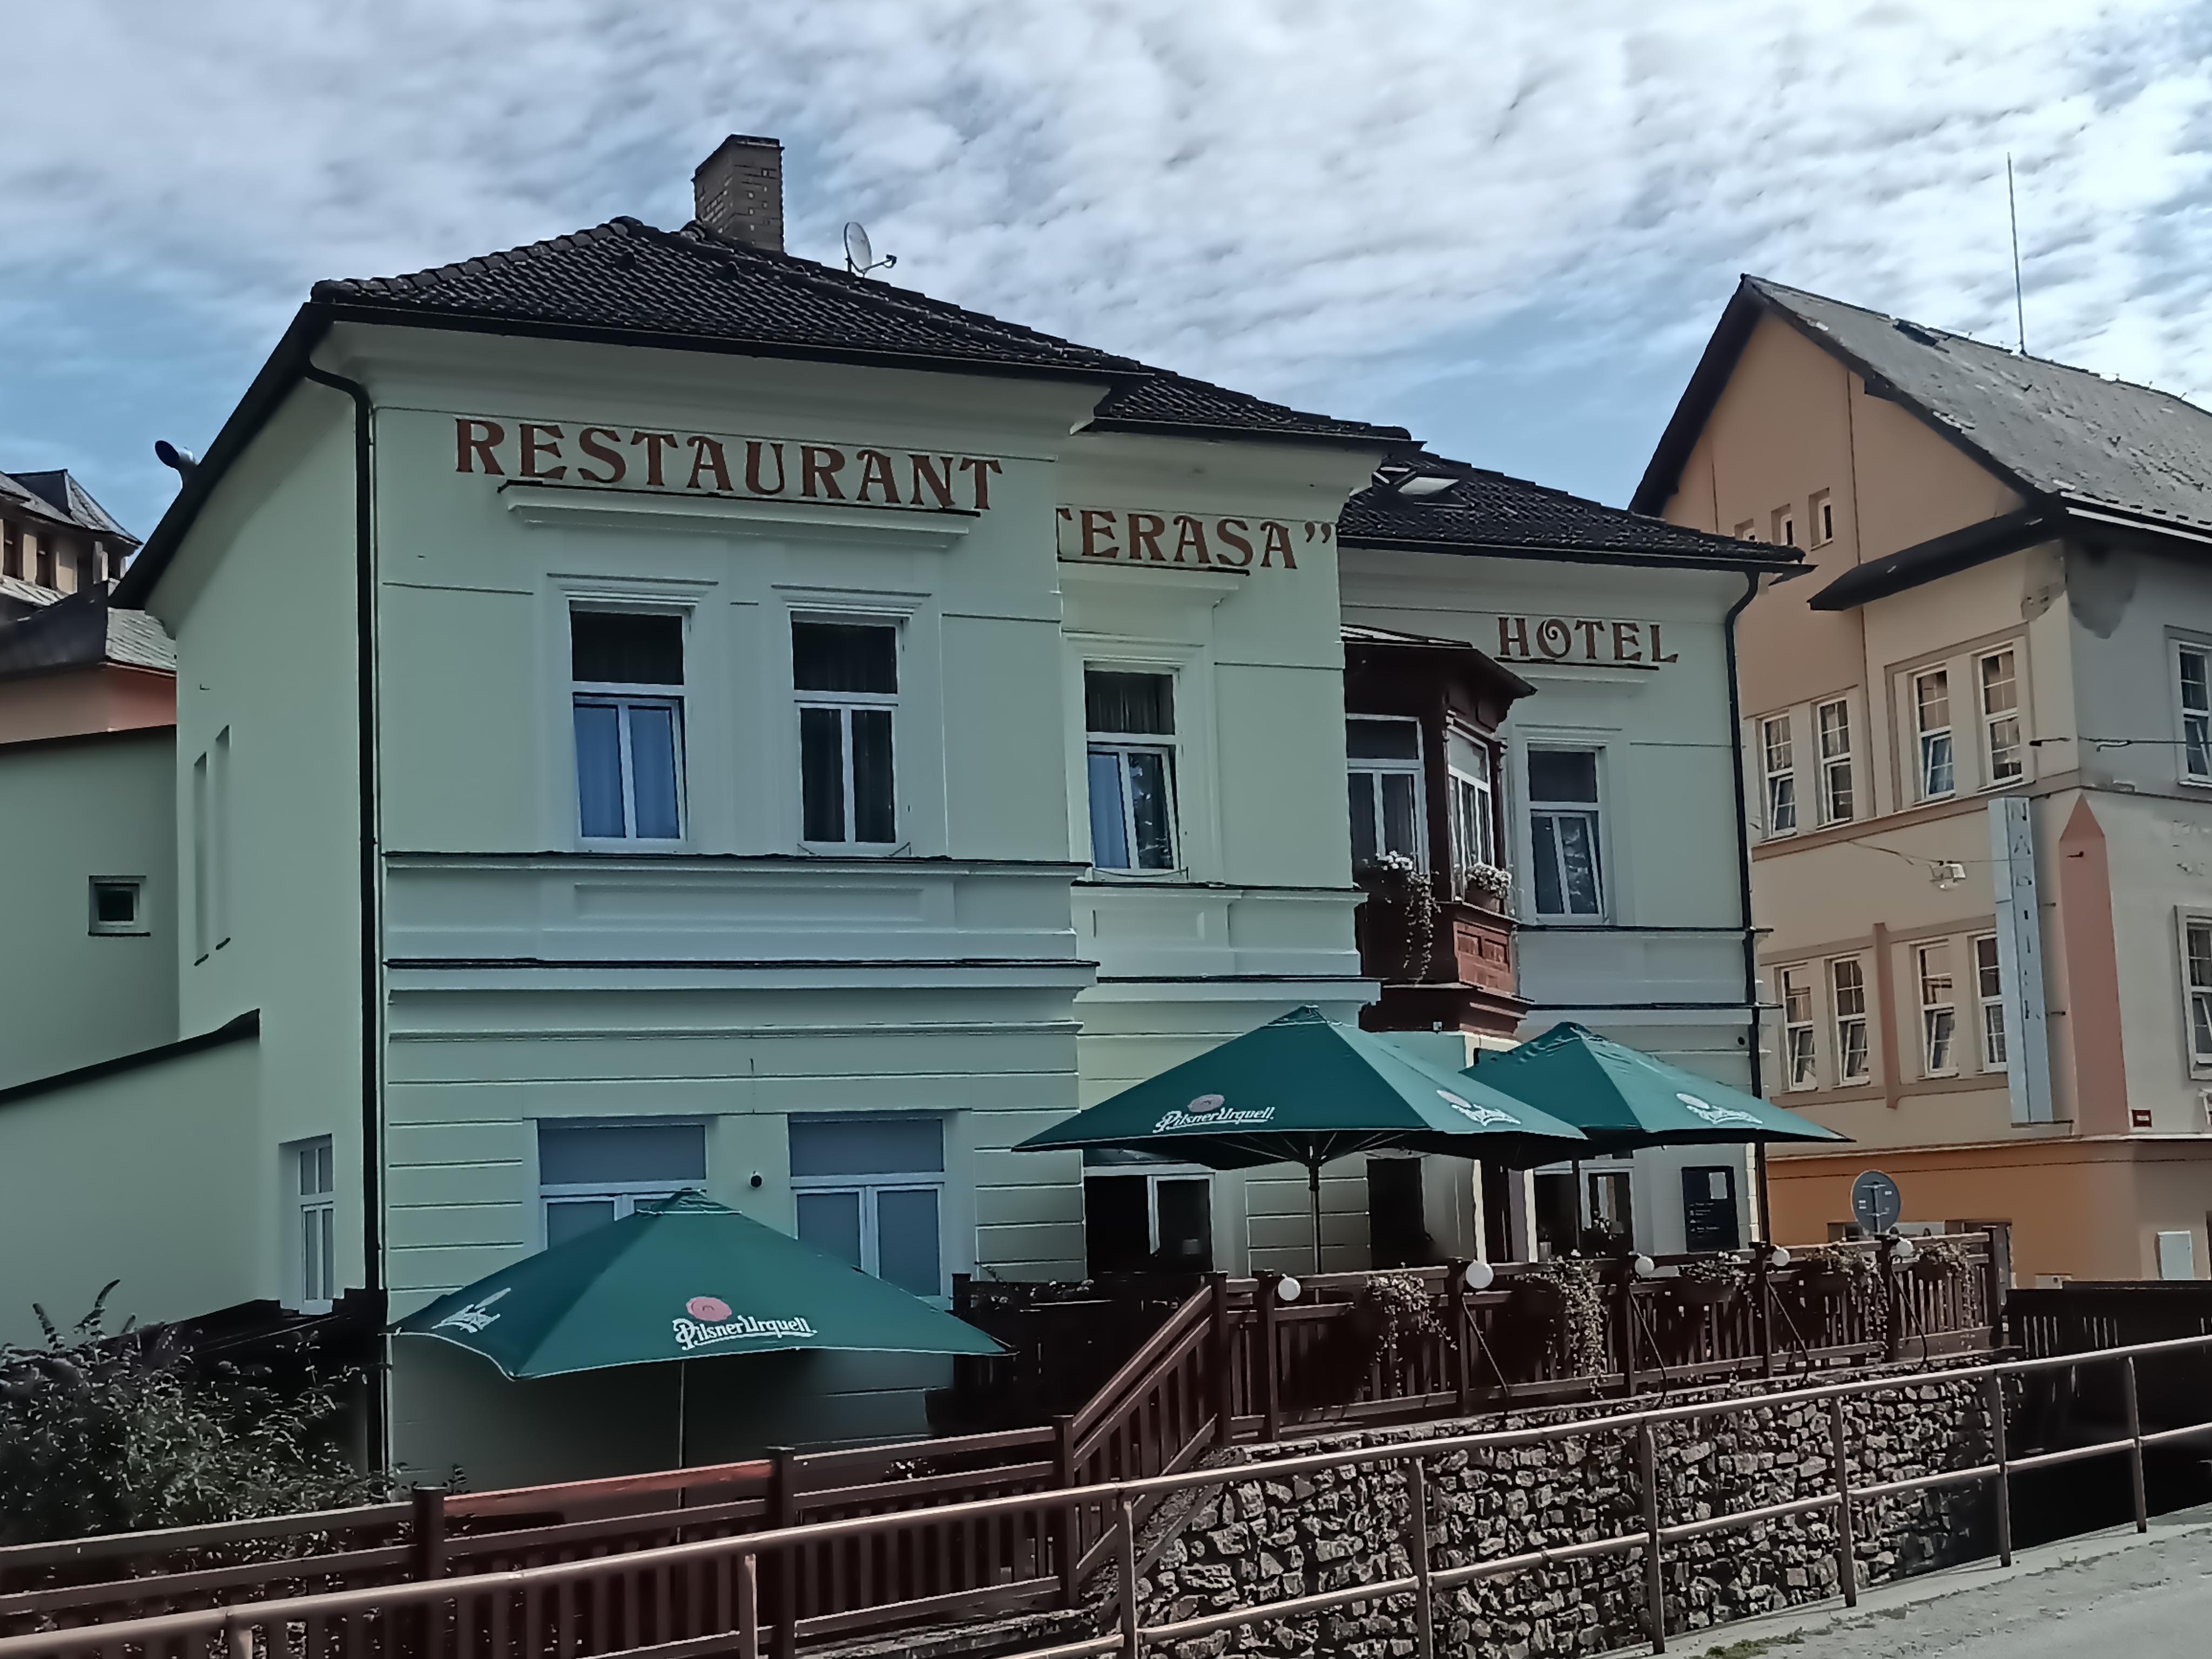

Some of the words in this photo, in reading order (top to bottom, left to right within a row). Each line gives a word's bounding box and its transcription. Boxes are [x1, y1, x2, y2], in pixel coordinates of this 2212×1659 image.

[456, 418, 1002, 509] RESTAURANT
[1499, 617, 1678, 663] HOTEL
[1152, 1110, 1217, 1133] Pilsner
[672, 1318, 744, 1350] Pilsner
